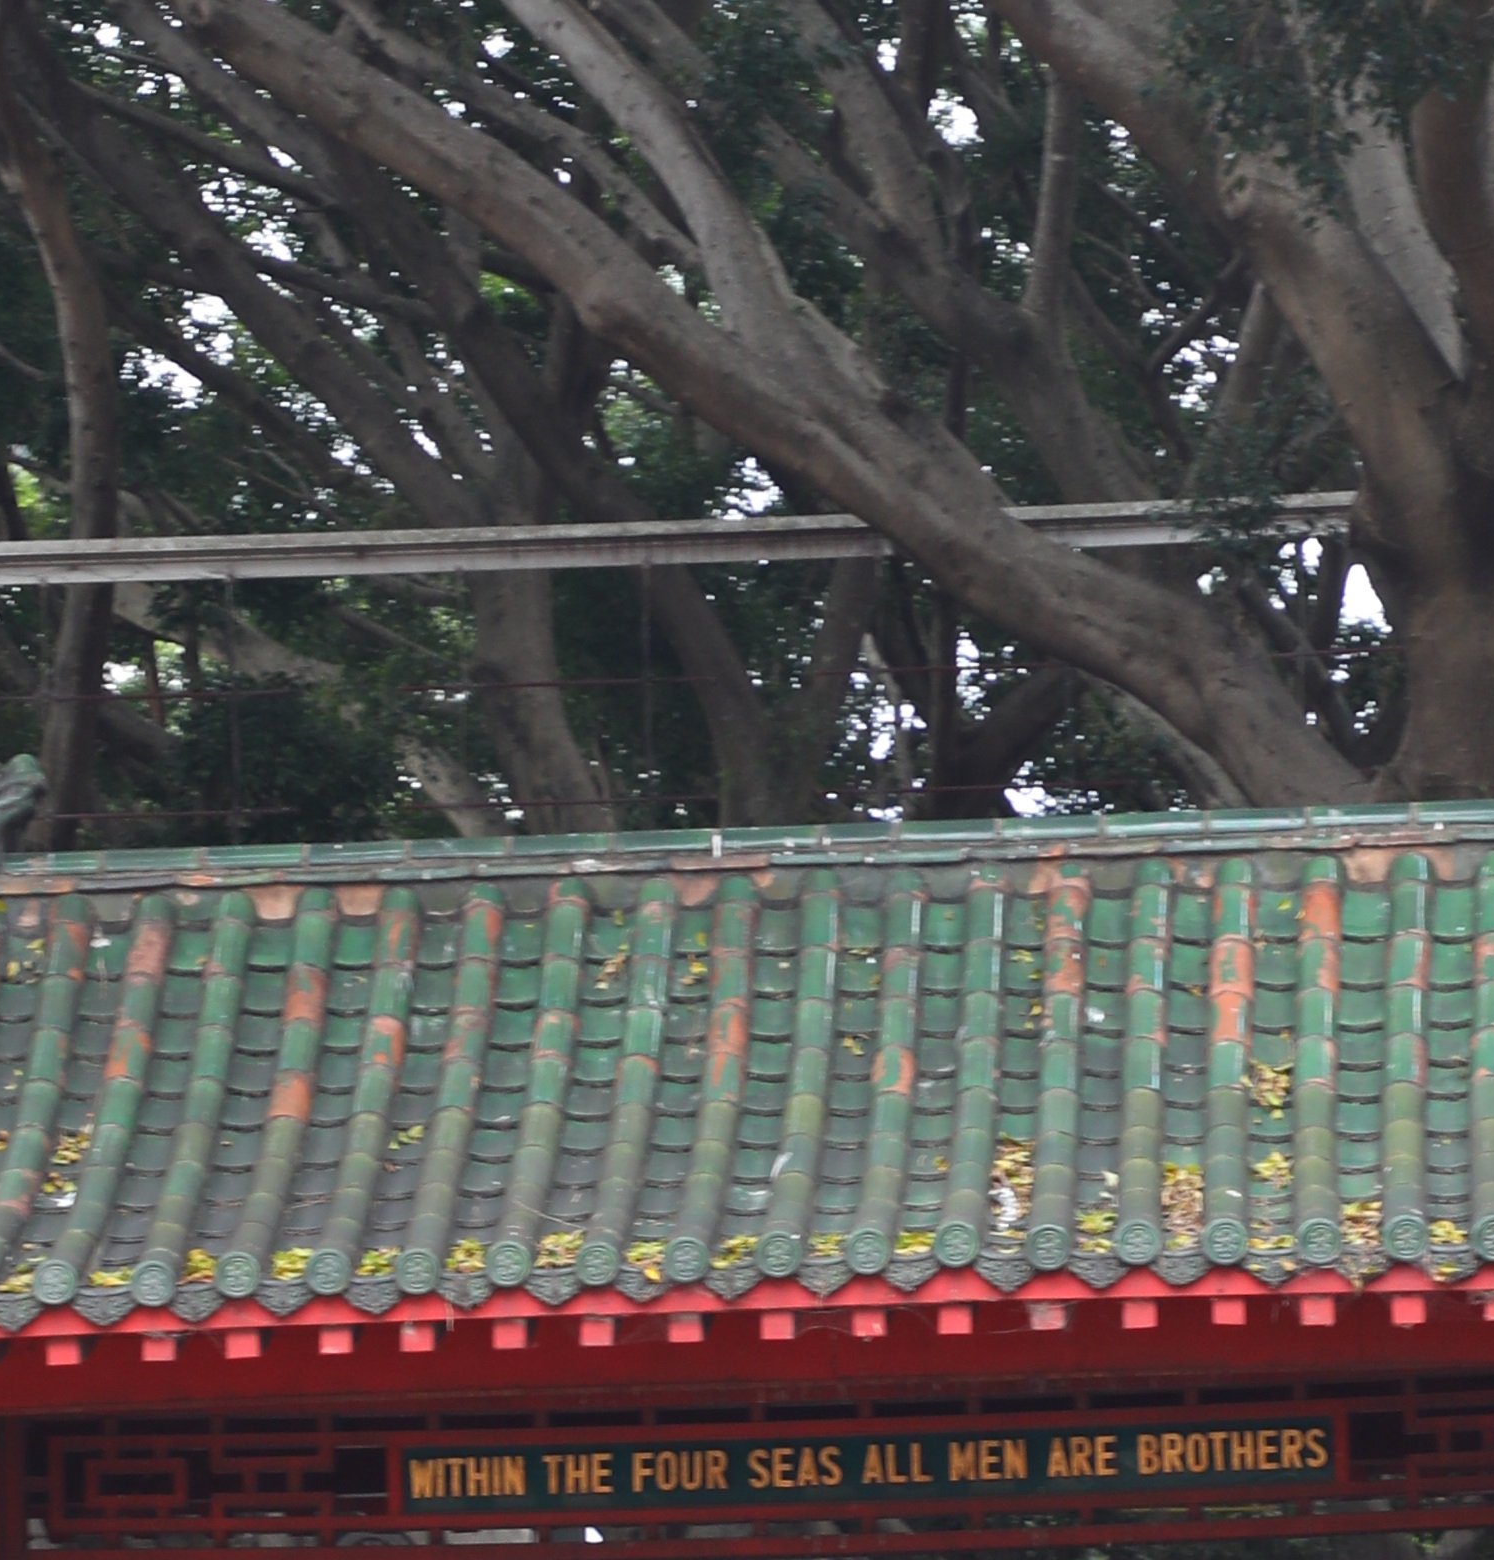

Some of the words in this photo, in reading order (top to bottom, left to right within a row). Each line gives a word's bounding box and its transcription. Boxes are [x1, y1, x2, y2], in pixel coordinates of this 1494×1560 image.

[410, 1455, 526, 1499] WITHIN
[542, 1453, 614, 1495] THE
[631, 1449, 729, 1493] FOUR
[746, 1445, 843, 1489] SEAS
[861, 1441, 934, 1485] ALL
[948, 1439, 1028, 1482] MEN
[1046, 1434, 1118, 1478] ARE
[1136, 1428, 1329, 1477] BROTHERS
